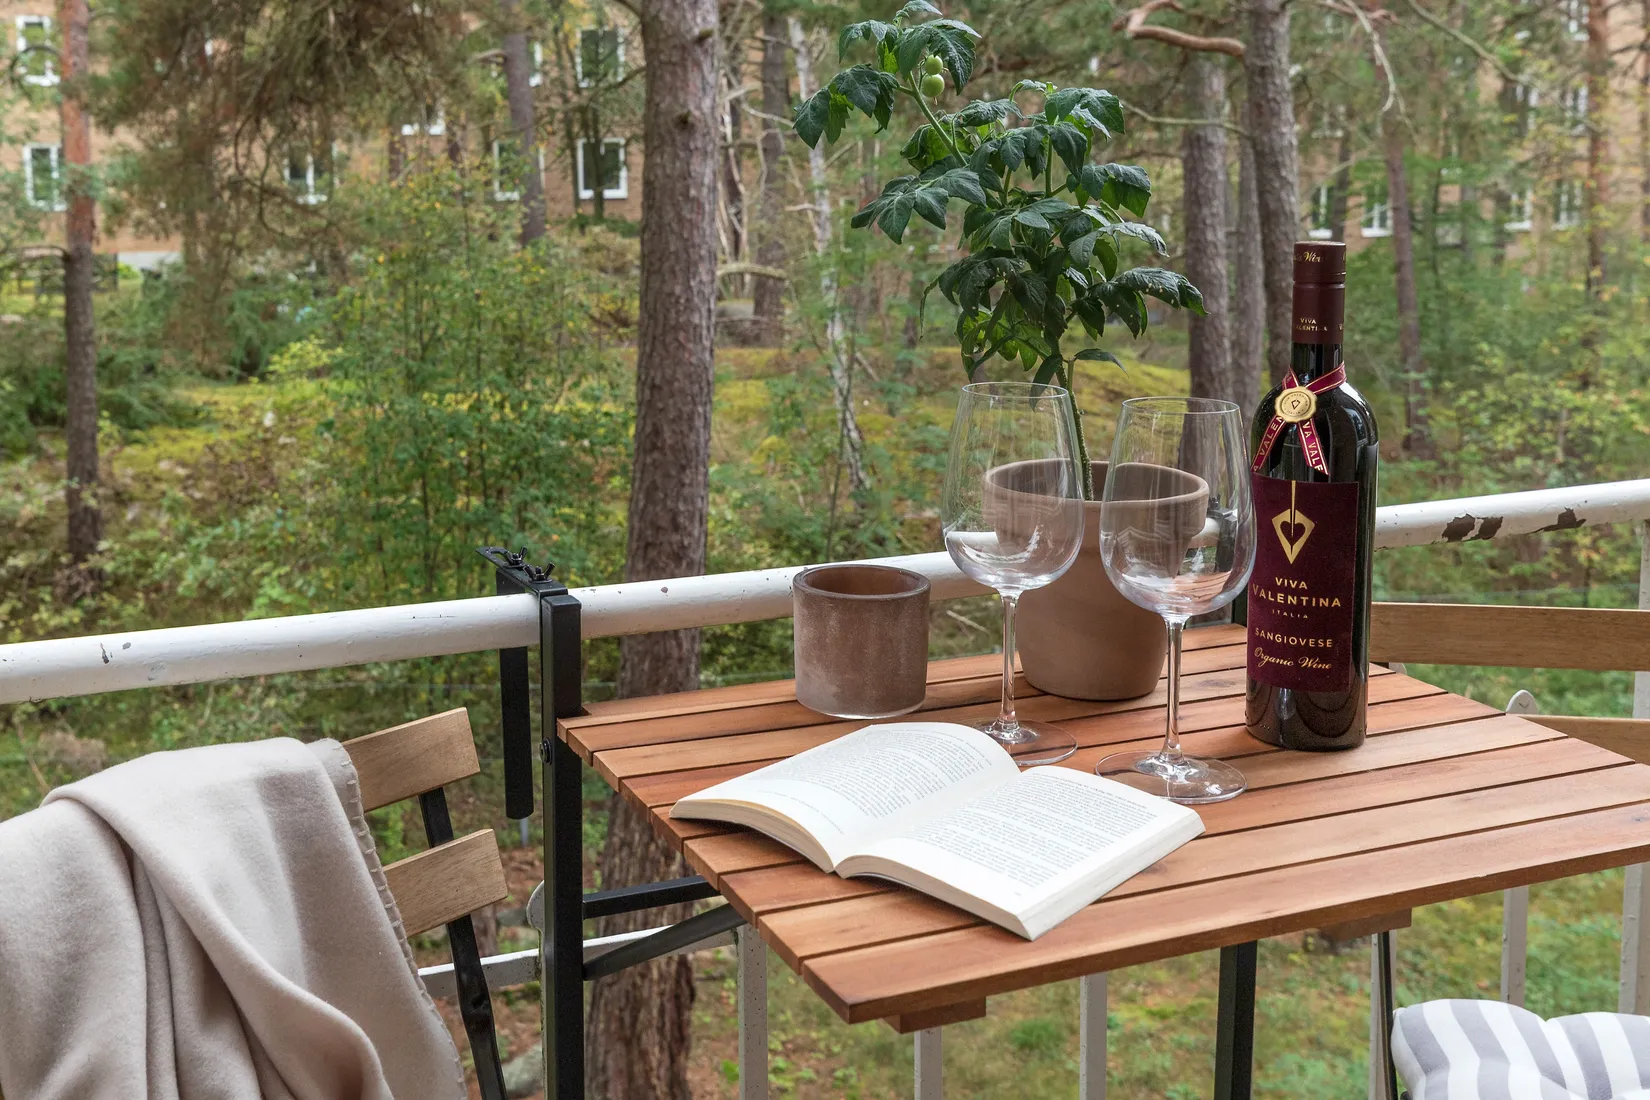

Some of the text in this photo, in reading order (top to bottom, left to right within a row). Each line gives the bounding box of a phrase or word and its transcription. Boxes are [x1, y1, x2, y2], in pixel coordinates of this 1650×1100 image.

[1275, 577, 1308, 590] VIVA
[1252, 583, 1341, 607] VALENTINA
[1272, 609, 1308, 619] ITALIA
[1254, 627, 1333, 648] SANGIOVESE
[1253, 646, 1333, 670] Organic Wine
